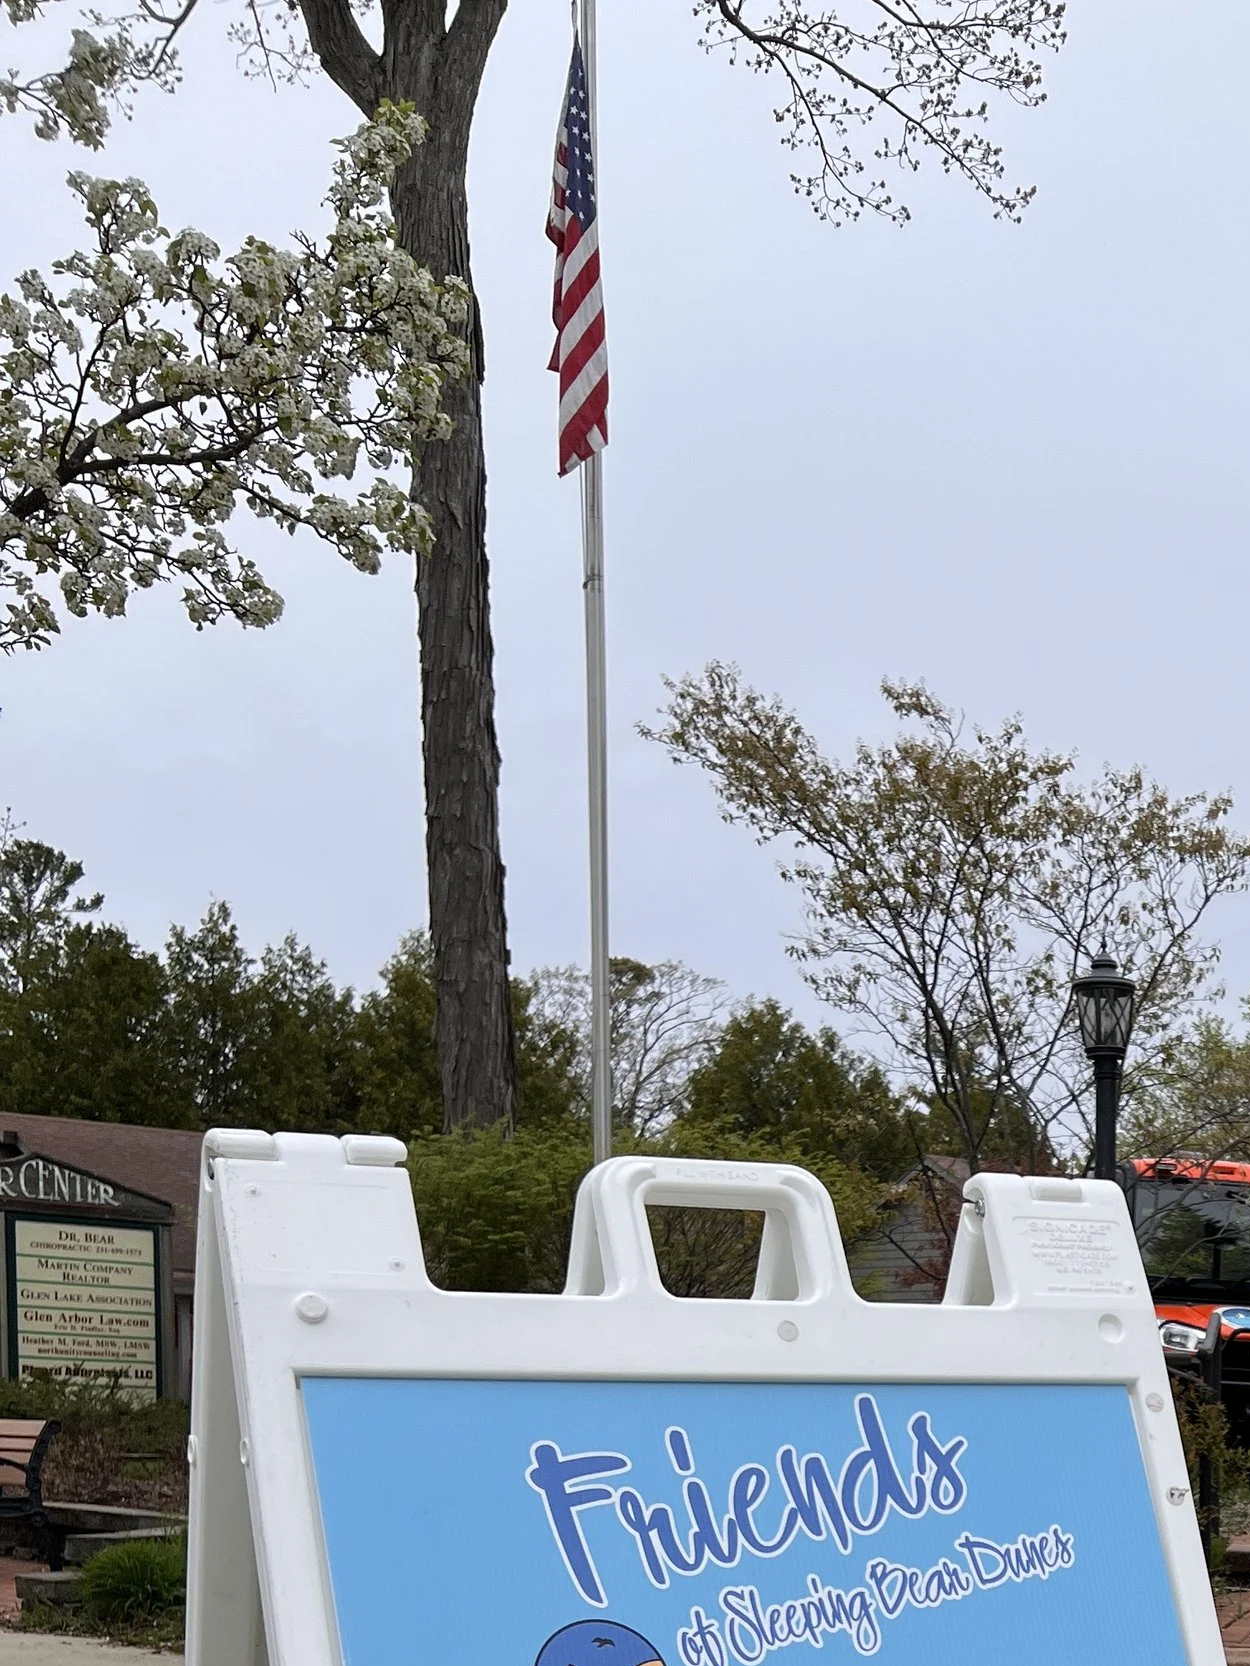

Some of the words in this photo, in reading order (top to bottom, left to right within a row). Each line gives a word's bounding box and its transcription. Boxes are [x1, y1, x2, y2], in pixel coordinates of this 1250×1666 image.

[20, 1158, 120, 1206] CENTER
[30, 1241, 93, 1253] CHIROPRACTIC
[85, 1232, 115, 1245] BEAR
[38, 1258, 80, 1272] MARTIN
[84, 1261, 134, 1276] COMPANY
[63, 1271, 111, 1284] REALTOR
[21, 1288, 51, 1301] GLEN
[54, 1290, 83, 1303] LAKE
[87, 1292, 153, 1308] ASSOCIATION
[24, 1310, 53, 1322] Glen
[60, 1311, 93, 1325] Arbor
[100, 1314, 150, 1328] Law.com
[526, 1393, 966, 1607] Friends
[718, 1575, 882, 1656] Sleeping
[866, 1555, 970, 1617] Bear
[956, 1526, 1075, 1588] Dunes
